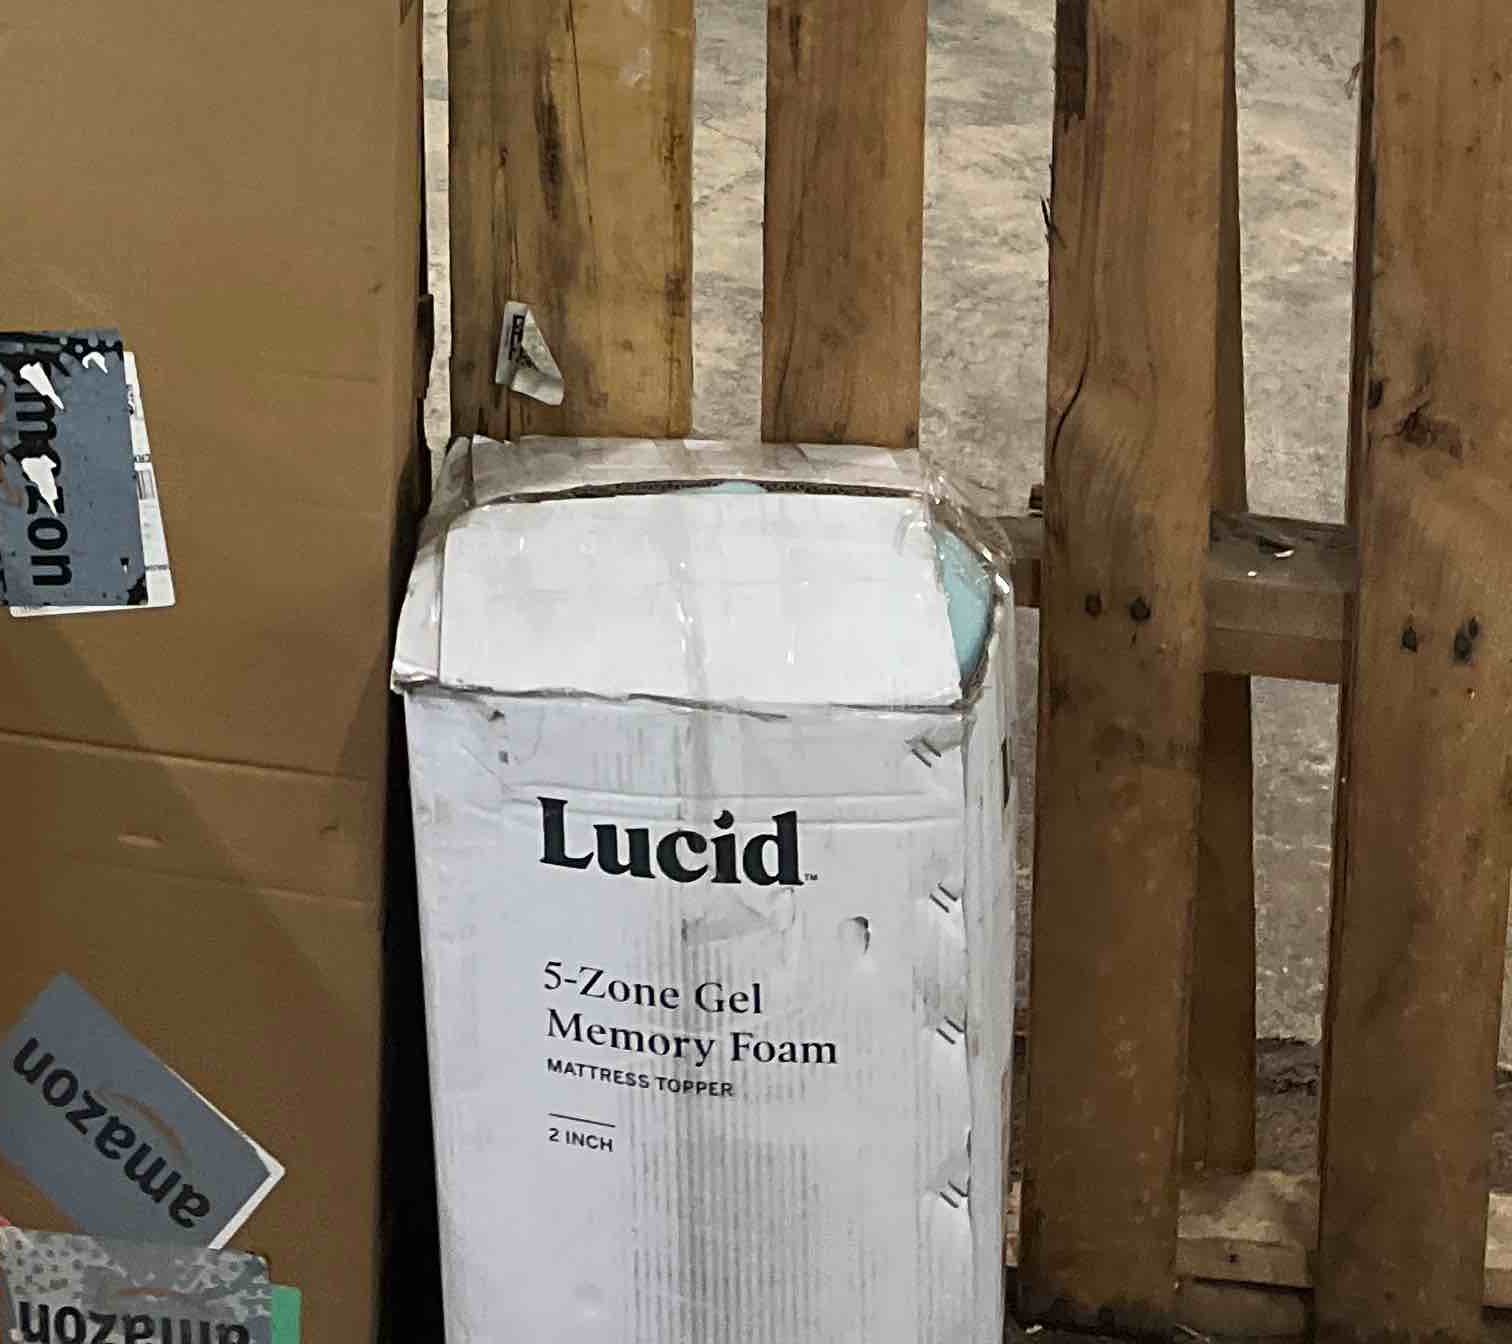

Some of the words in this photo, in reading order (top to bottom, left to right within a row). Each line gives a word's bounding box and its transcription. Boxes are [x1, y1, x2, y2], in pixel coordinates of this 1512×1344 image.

[13, 352, 73, 587] mzon
[537, 796, 805, 887] Lucid
[543, 960, 680, 1010] 5-Zone
[694, 981, 763, 1015] Gel
[546, 1008, 716, 1067] Memory
[729, 1031, 839, 1065] Foam
[546, 1057, 650, 1090] MATTRESS
[655, 1074, 735, 1098] TOPPER
[11, 1036, 212, 1229] amazon
[547, 1127, 561, 1143] 2
[565, 1130, 615, 1152] INCH
